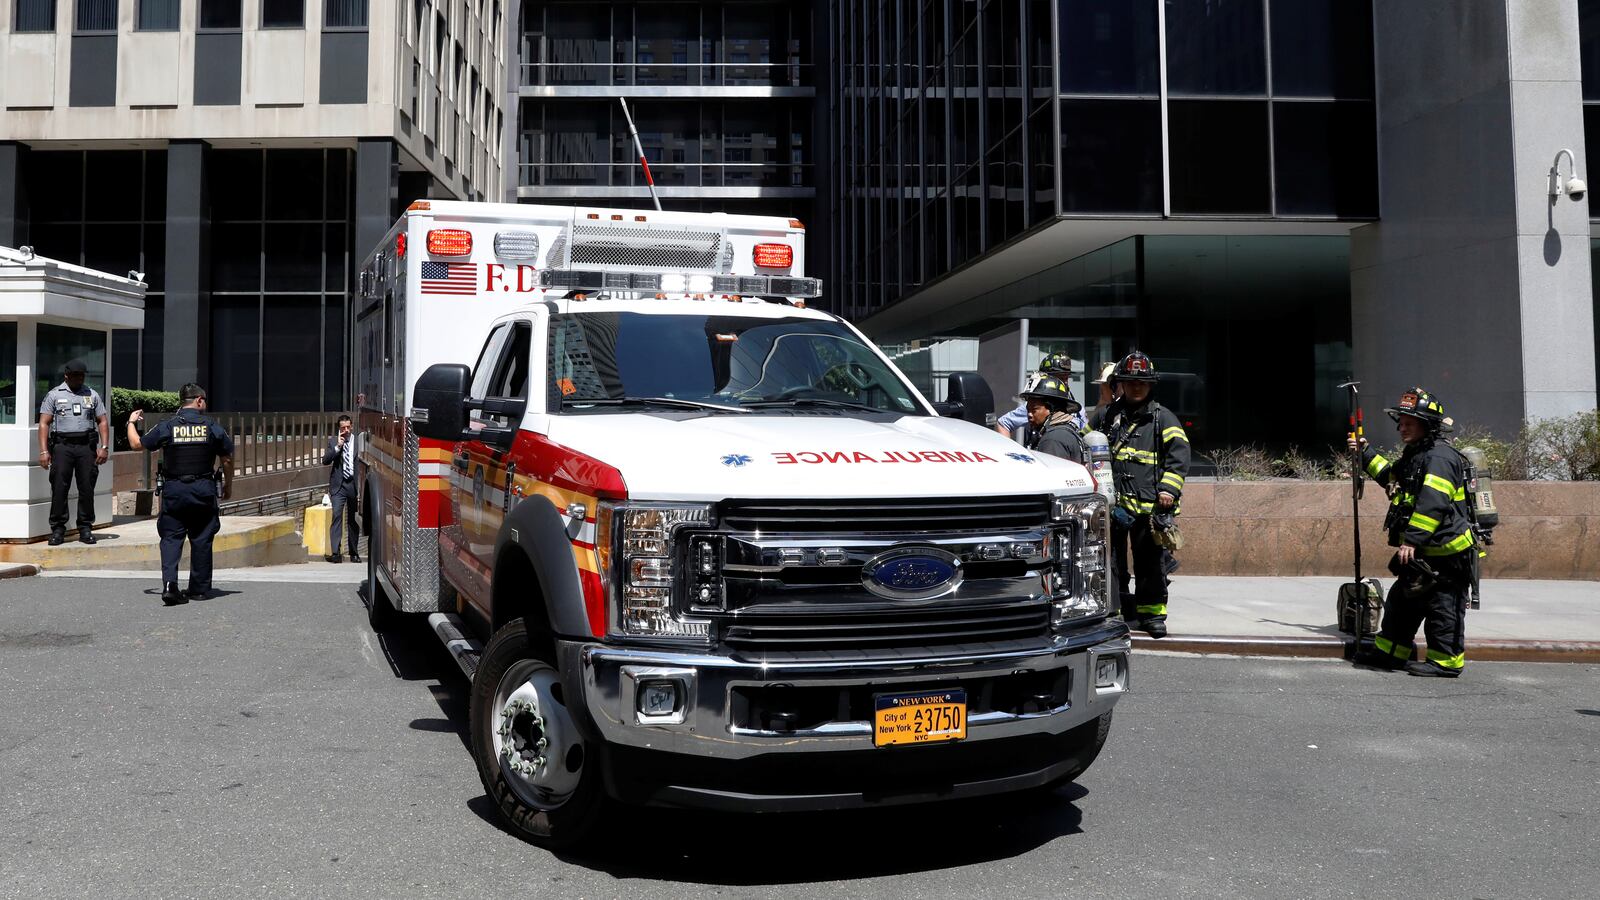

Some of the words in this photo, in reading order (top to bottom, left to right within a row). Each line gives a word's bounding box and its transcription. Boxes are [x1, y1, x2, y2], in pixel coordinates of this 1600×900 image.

[173, 426, 207, 438] POLICE
[899, 698, 921, 706] NEW
[922, 696, 944, 704] YORK
[884, 713, 899, 723] City
[899, 713, 907, 721] of
[914, 709, 923, 720] A
[925, 706, 961, 732] 3750
[879, 725, 894, 734] New
[896, 724, 911, 732] York
[914, 722, 923, 733] Z
